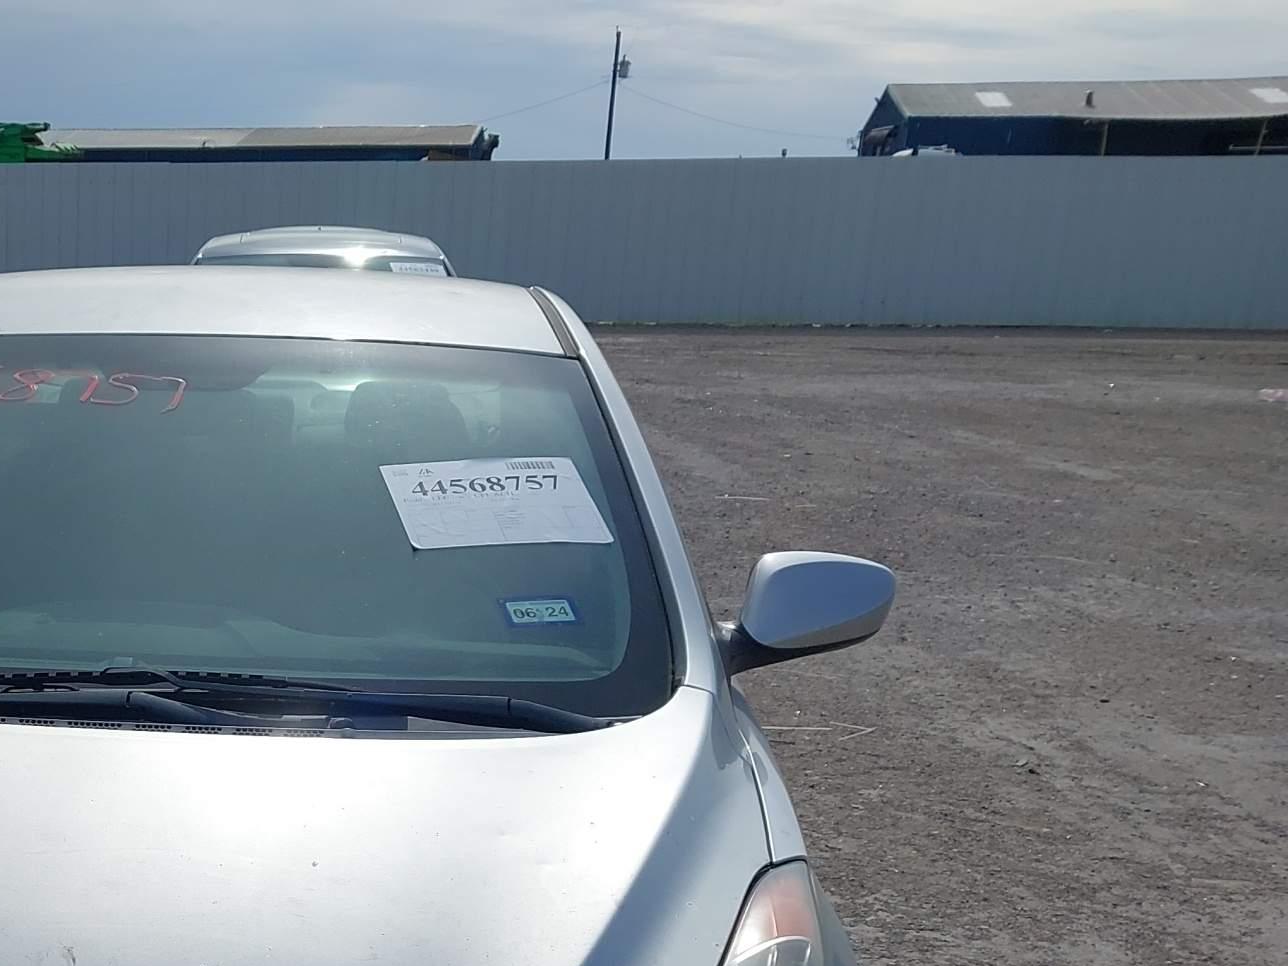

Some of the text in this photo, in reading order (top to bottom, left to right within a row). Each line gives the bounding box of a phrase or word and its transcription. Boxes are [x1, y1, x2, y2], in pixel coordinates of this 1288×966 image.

[411, 474, 558, 497] 44568757
[512, 606, 569, 619] 06 24
